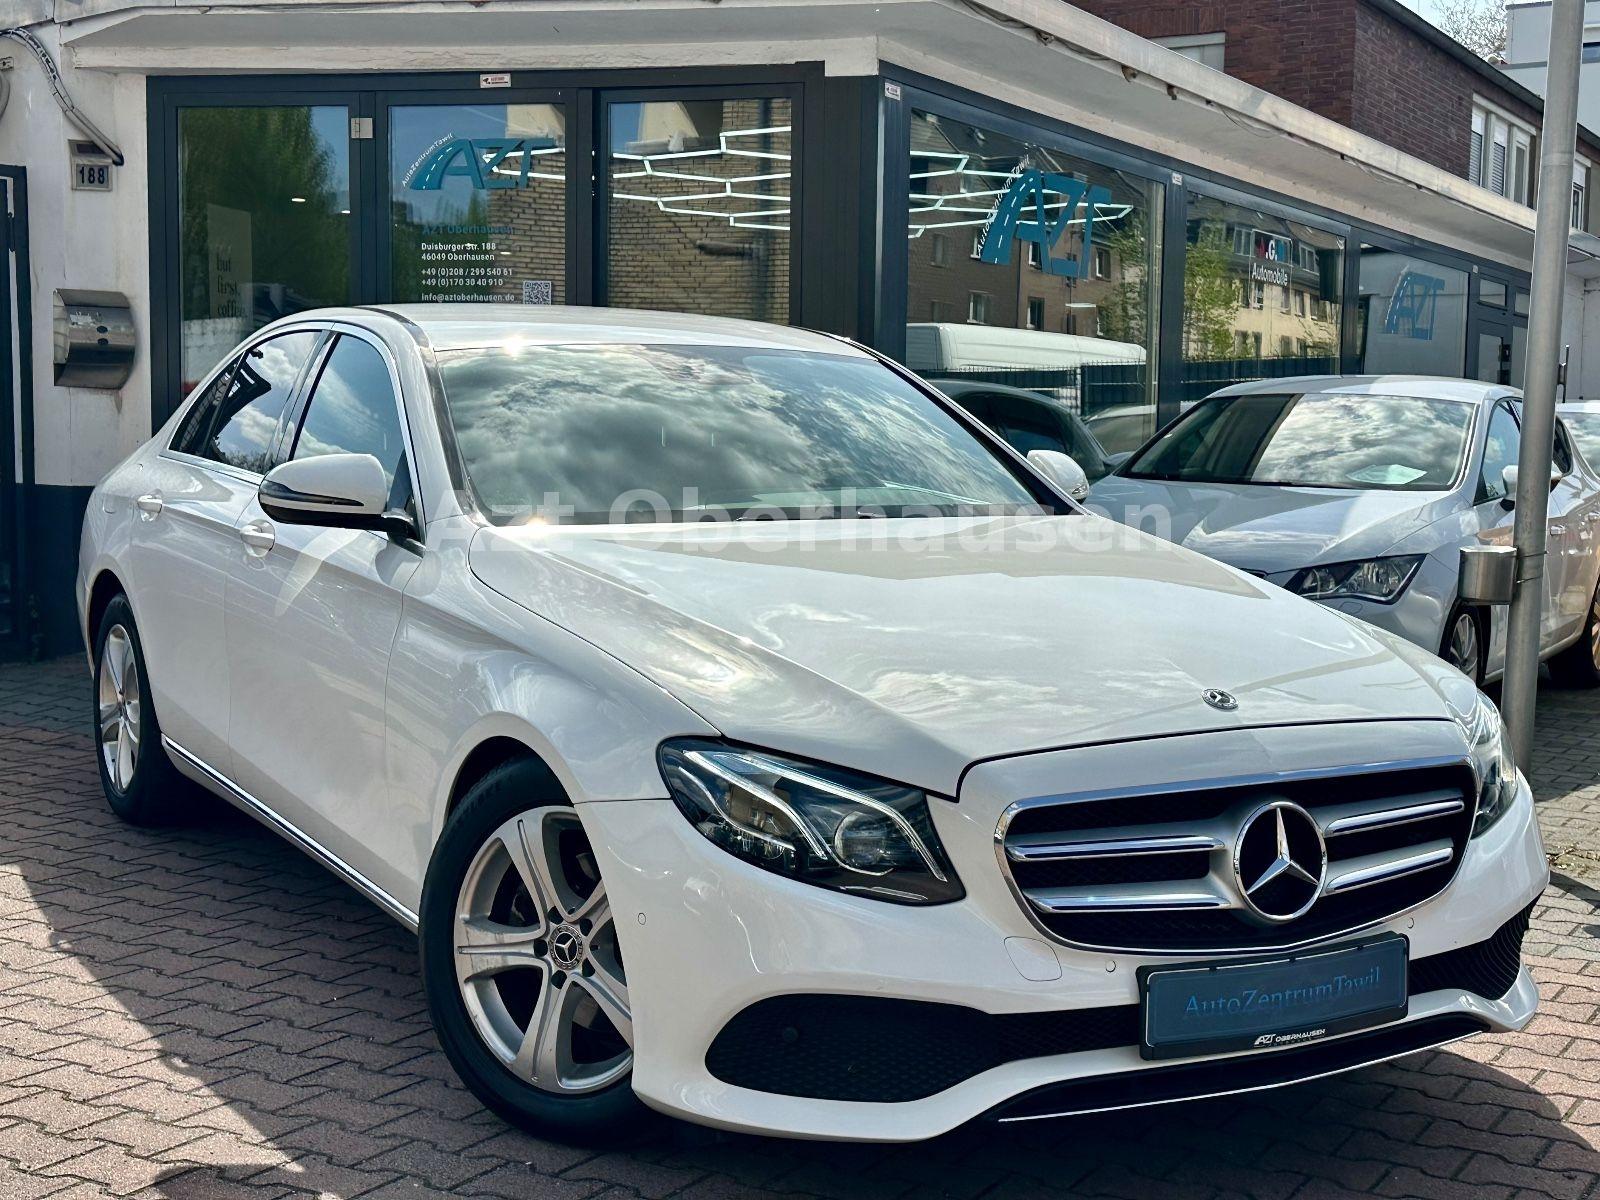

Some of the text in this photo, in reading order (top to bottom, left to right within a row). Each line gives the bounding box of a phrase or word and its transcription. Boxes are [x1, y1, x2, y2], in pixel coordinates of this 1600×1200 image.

[409, 138, 555, 190] AZT
[79, 166, 105, 184] 188
[981, 167, 1112, 279] AZT
[421, 242, 496, 252] Duisburger Str. 188
[421, 252, 495, 261] 46049 Oberhausen
[421, 268, 436, 276] +49
[438, 267, 464, 277] (0)208
[470, 268, 485, 276] 299
[486, 268, 501, 276] 540
[503, 268, 513, 276] 61
[1251, 262, 1288, 287] Automobile
[421, 278, 504, 287] +49 (0)170 30 40 910
[421, 293, 515, 303] info@aztoberhausen.de
[1254, 1033, 1276, 1046] AZT
[1275, 1028, 1326, 1042] OBERHAUSEN
